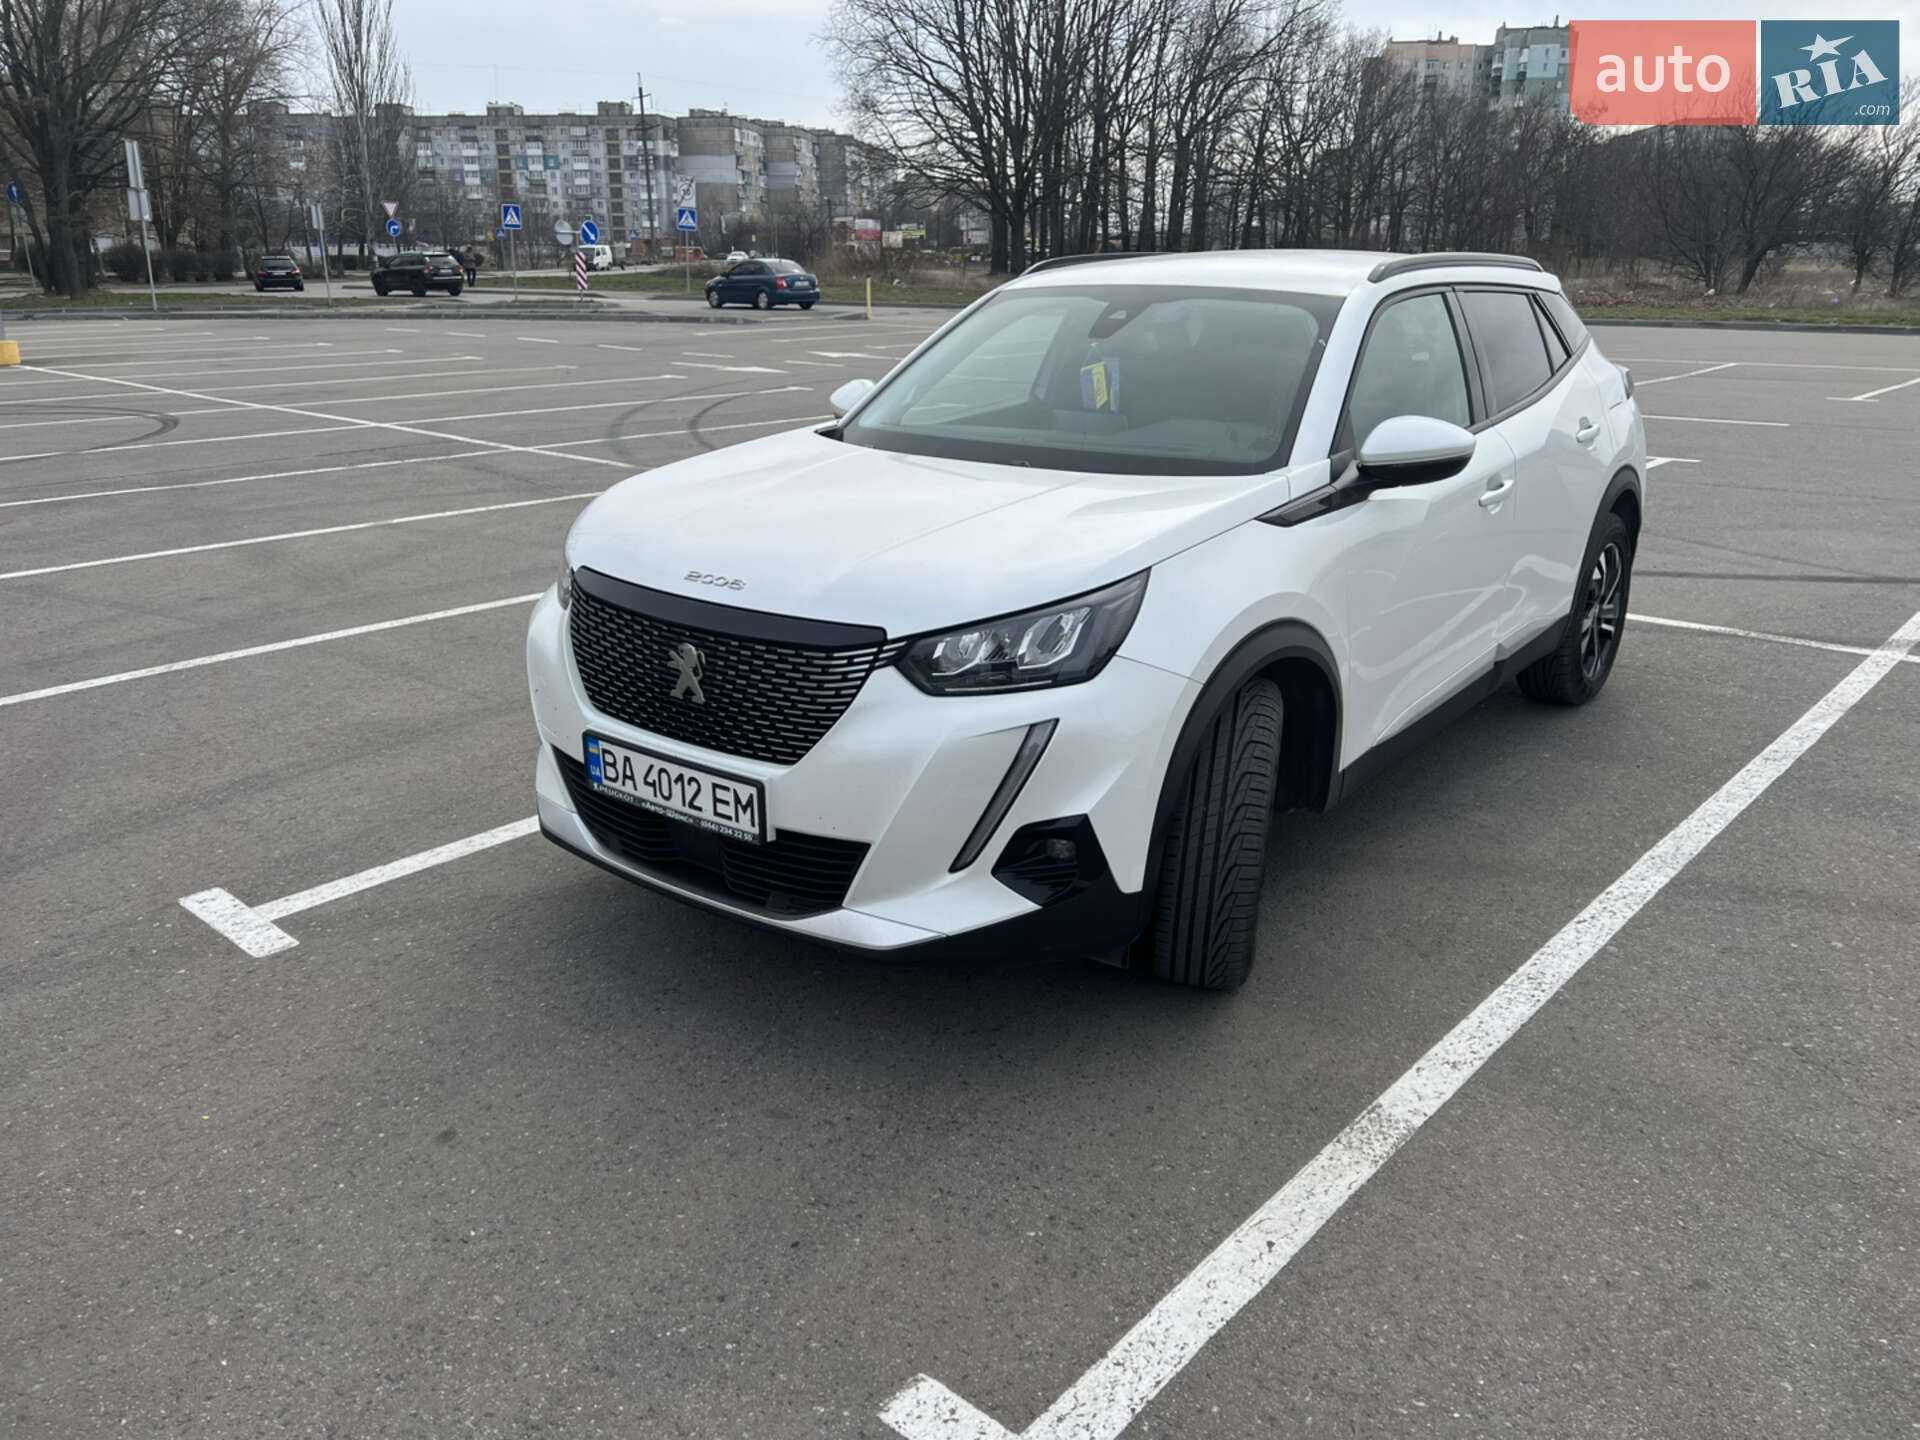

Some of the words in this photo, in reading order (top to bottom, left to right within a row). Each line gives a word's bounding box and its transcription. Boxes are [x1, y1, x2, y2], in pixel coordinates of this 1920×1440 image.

[590, 764, 601, 777] UA
[601, 747, 638, 791] BA
[643, 763, 703, 812] 4012
[711, 782, 756, 828] EM
